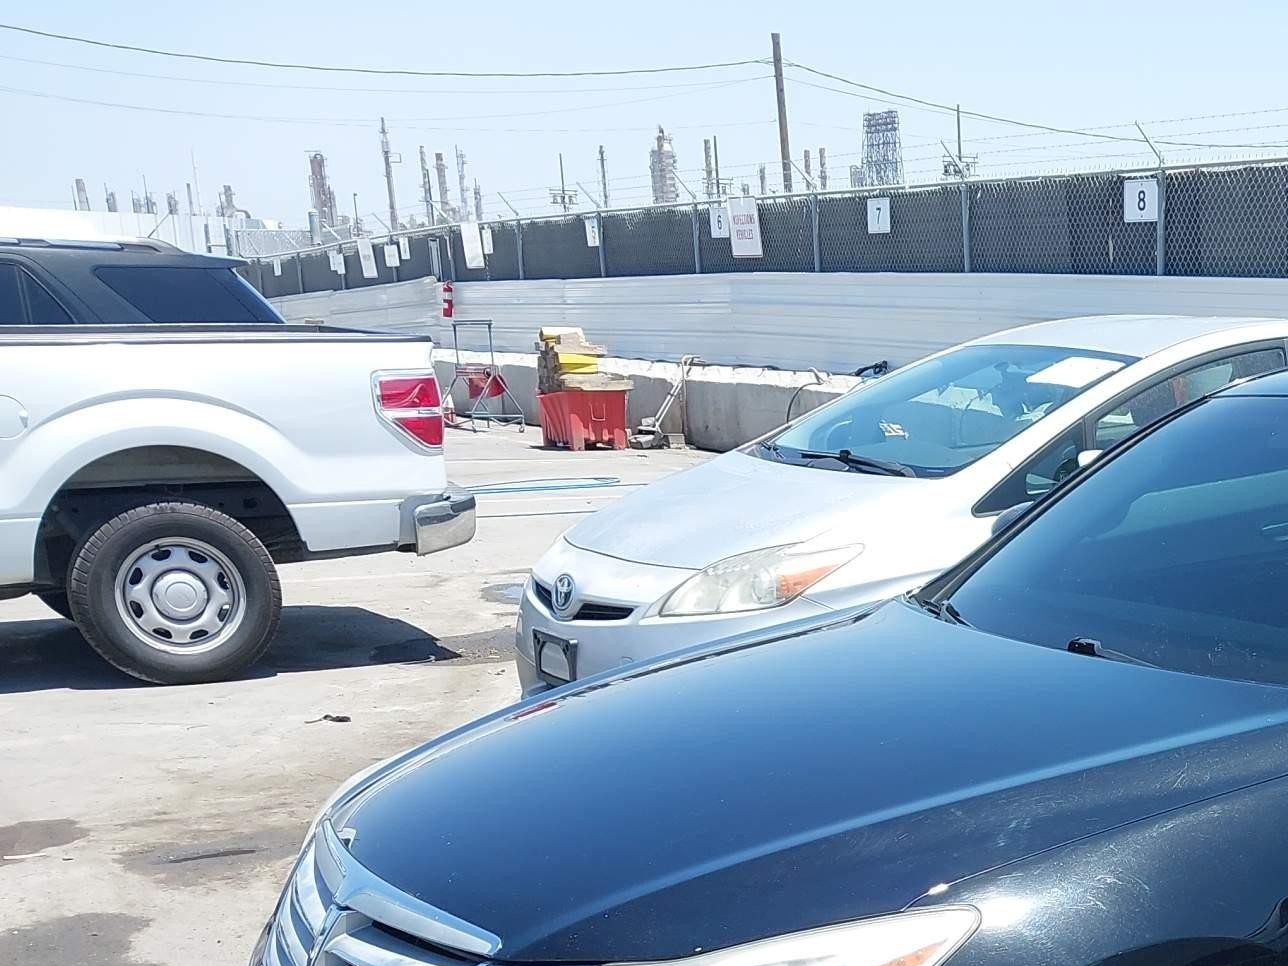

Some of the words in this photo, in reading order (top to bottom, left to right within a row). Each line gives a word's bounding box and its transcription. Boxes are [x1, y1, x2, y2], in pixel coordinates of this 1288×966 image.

[1137, 190, 1147, 211] 8
[717, 214, 723, 231] 6
[876, 207, 882, 225] 7
